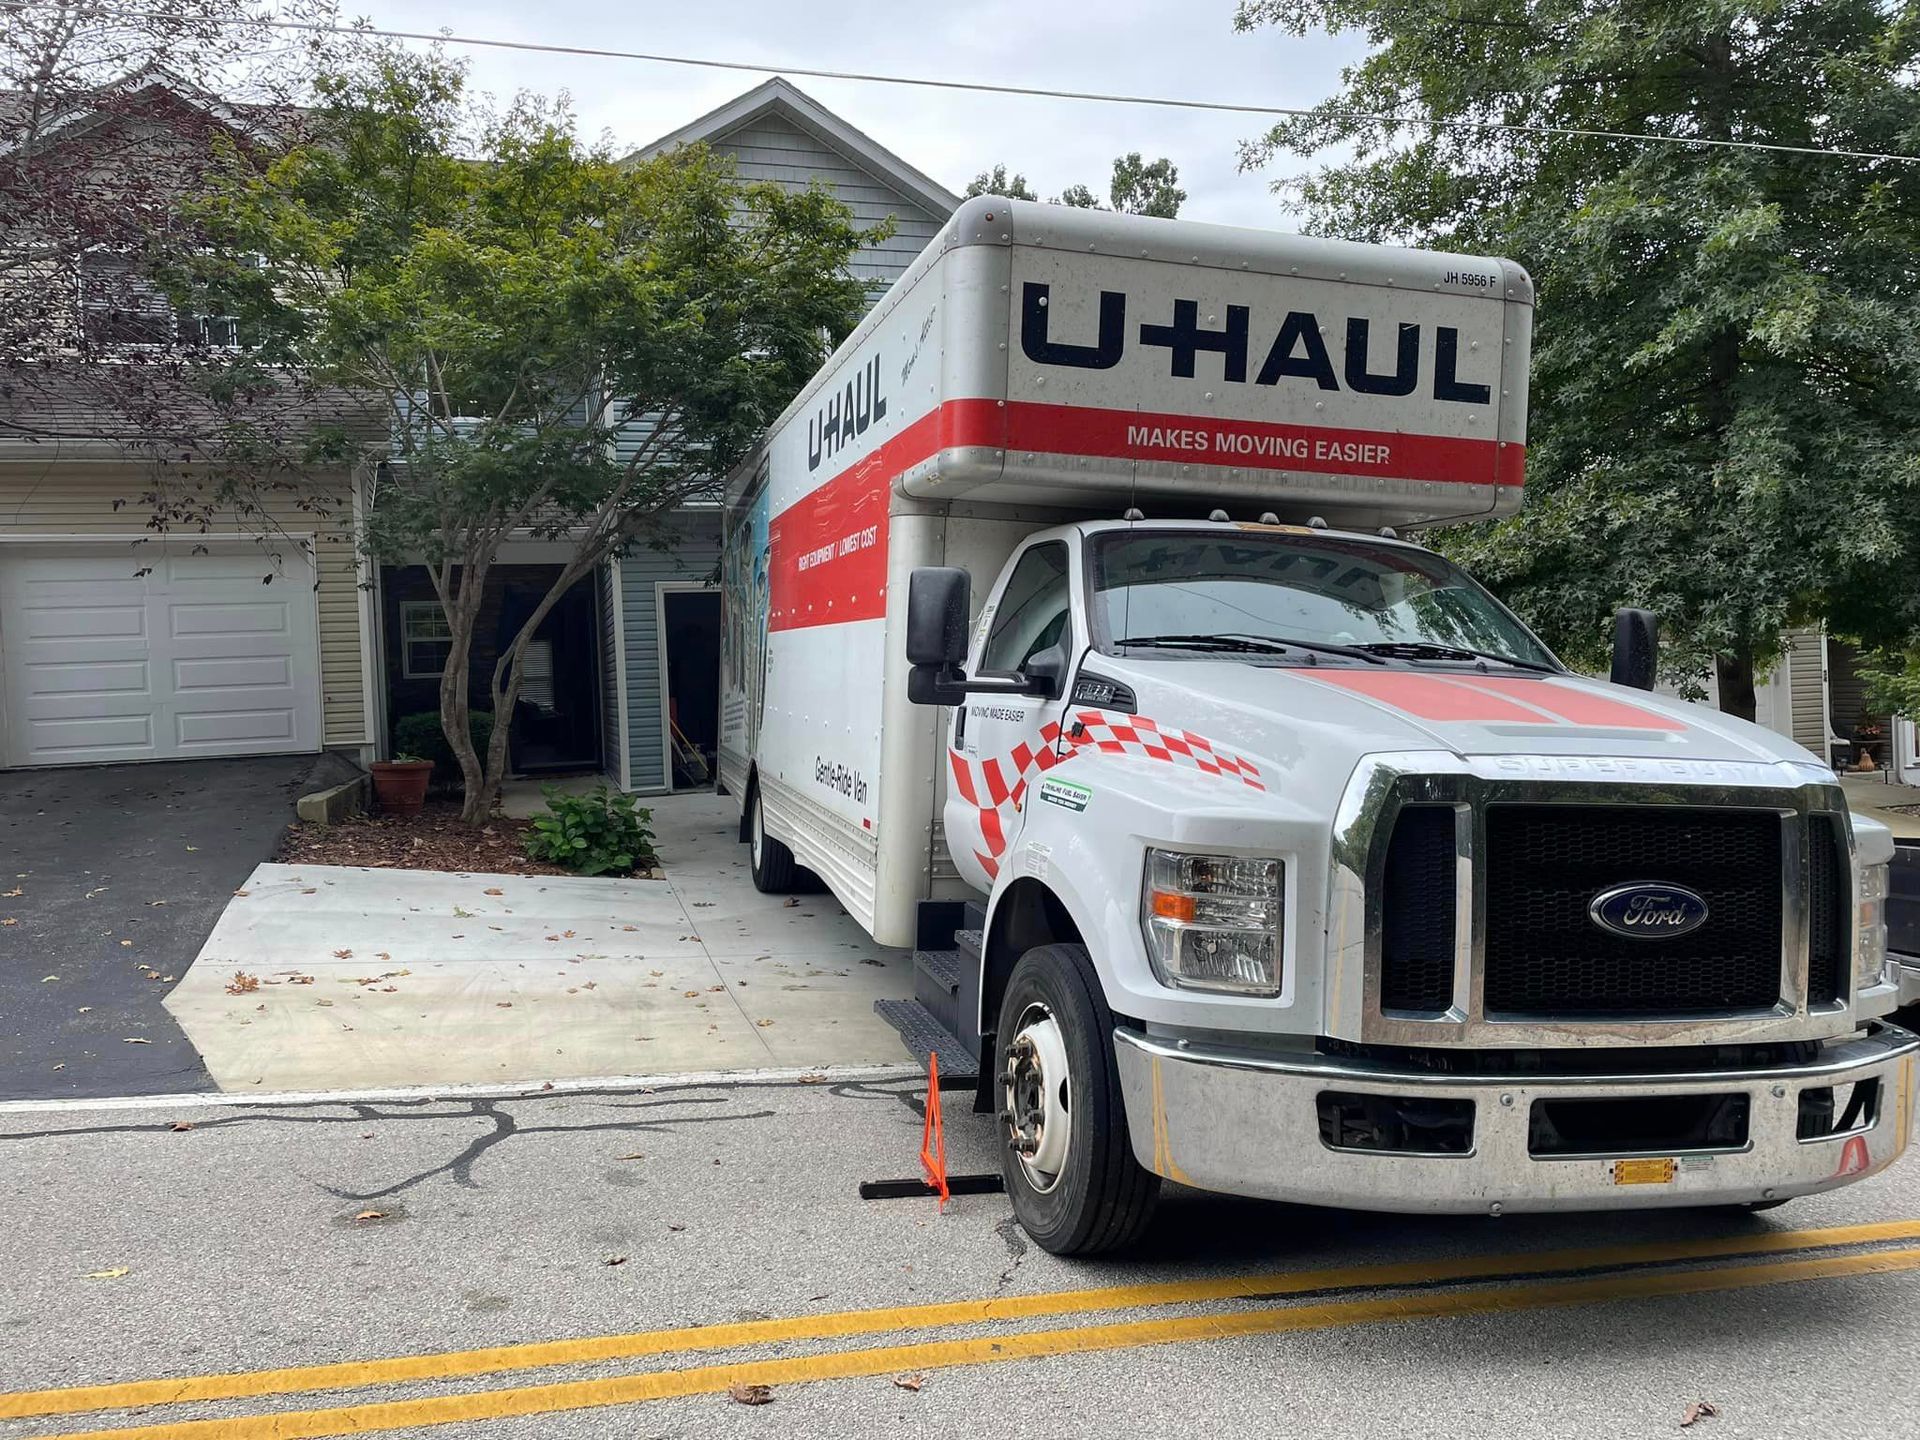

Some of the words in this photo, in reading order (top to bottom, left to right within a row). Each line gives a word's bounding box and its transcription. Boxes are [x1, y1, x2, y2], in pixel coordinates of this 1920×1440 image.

[1444, 271, 1458, 284] JH
[1461, 273, 1487, 287] 5956
[1489, 276, 1497, 288] F
[1127, 426, 1209, 451] MAKES
[1215, 433, 1309, 459] MOVING
[1315, 441, 1391, 465] EASIER
[839, 532, 860, 557] LOWEST
[861, 524, 878, 548] COST
[971, 705, 989, 718] MOVING
[990, 707, 1004, 720] MADE
[1004, 708, 1025, 722] EASIER
[816, 755, 852, 798] Gentle-Ride
[854, 770, 867, 805] Van
[1623, 895, 1687, 925] Ford
